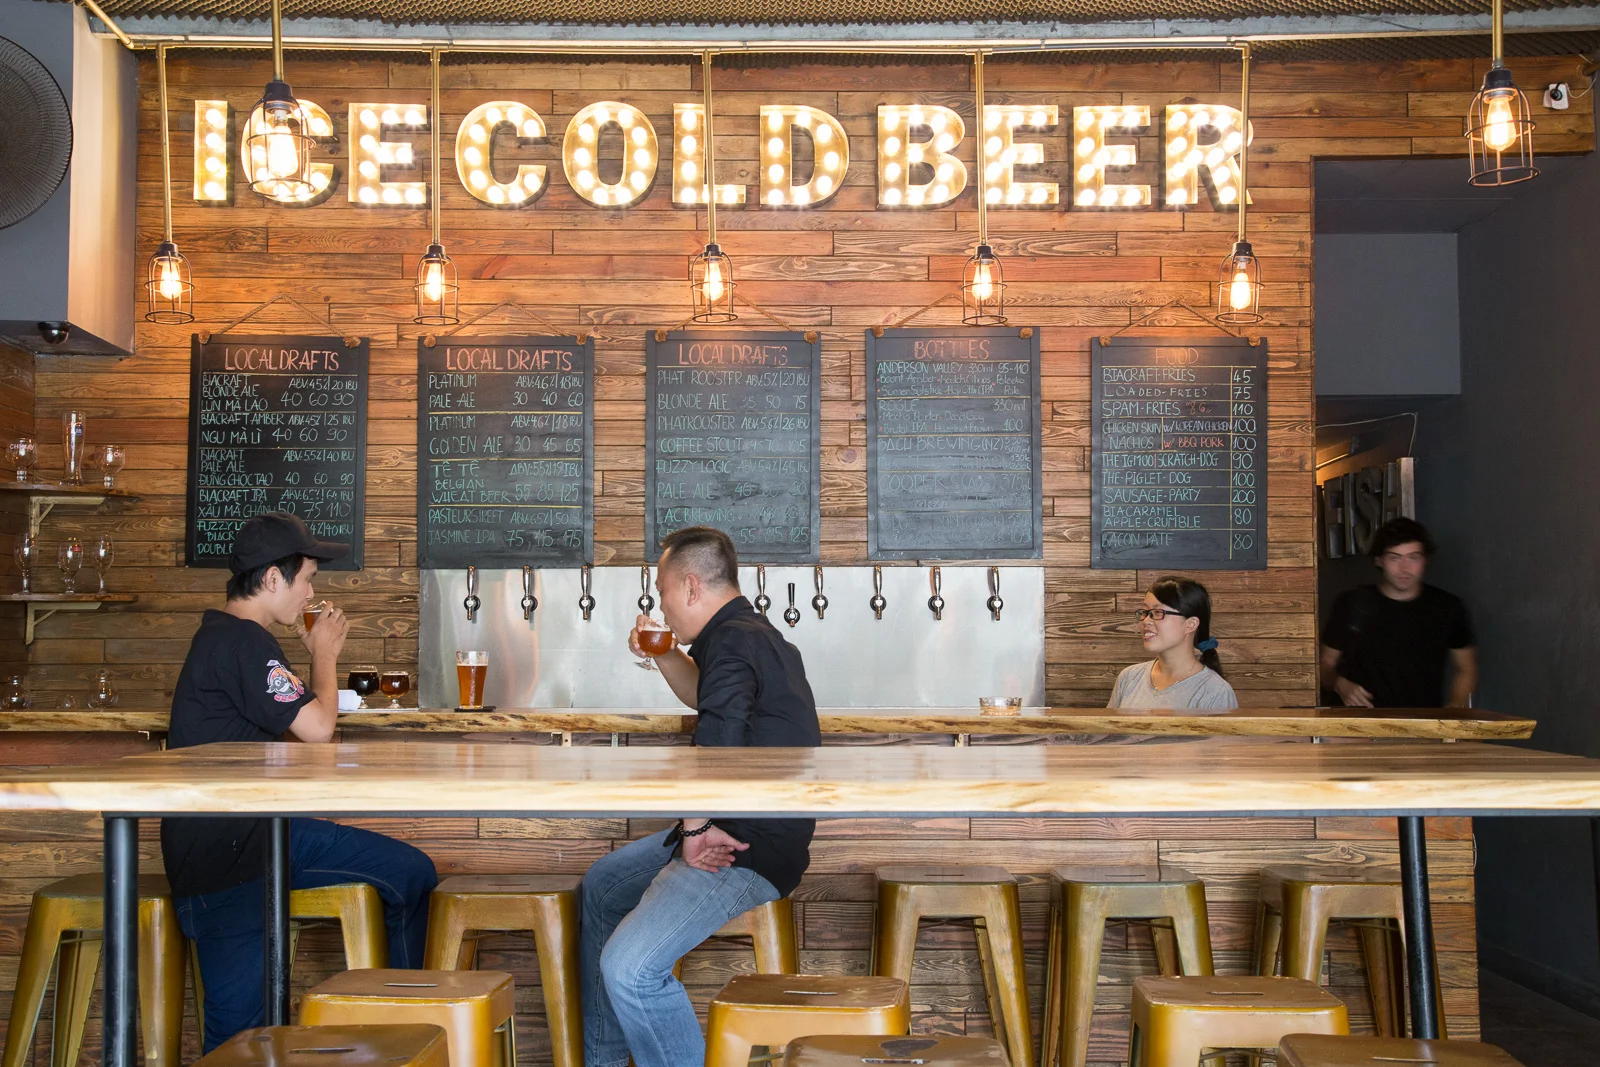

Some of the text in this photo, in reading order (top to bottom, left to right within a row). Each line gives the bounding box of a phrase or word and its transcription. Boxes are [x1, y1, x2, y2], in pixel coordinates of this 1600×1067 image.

[193, 98, 1254, 208] ICE COLD BEER
[679, 343, 788, 366] LOCAL DRAFTS
[914, 339, 991, 359] BOTTLES
[1155, 348, 1198, 365] FOOD
[225, 348, 339, 371] LOCAL DRAFTS
[446, 348, 572, 371] LOCAL DRAFTS
[877, 362, 929, 374] ANDERSON
[932, 363, 963, 374] VALLEY
[203, 374, 250, 387] BIACRAFT
[429, 374, 476, 389] PLATINUM
[657, 370, 685, 386] PHAT
[691, 370, 742, 386] ROOSTER
[1233, 370, 1251, 383] 45
[203, 384, 260, 397] BLONDE ALE
[1233, 387, 1251, 399] 75
[281, 391, 302, 407] 40
[309, 392, 328, 406] 60
[332, 393, 354, 406] 90
[429, 392, 584, 408] PALE ALE 30 40 60
[658, 394, 702, 410] BLONDE
[708, 394, 730, 410] ALE
[765, 395, 780, 409] 50
[793, 396, 807, 410] 75
[1233, 404, 1253, 415] 110
[201, 413, 249, 425] BIACRAFT
[251, 413, 284, 425] AMBER
[429, 415, 476, 431] PLATINUM
[1002, 419, 1023, 431] 100
[1102, 421, 1139, 434] CHICKEN
[1141, 422, 1161, 433] SKIN
[1233, 418, 1256, 432] 100
[202, 431, 225, 443] NGU
[230, 427, 247, 443] MÀ
[272, 429, 292, 442] 40
[300, 428, 318, 441] 60
[326, 429, 347, 441] 90
[1109, 436, 1154, 449] NACHOS
[1179, 436, 1197, 447] BBQ
[1200, 437, 1225, 447] PORK
[1233, 435, 1256, 450] 100
[483, 436, 503, 453] ALE
[514, 436, 530, 451] 30
[543, 438, 557, 451] 45
[566, 438, 582, 452] 65
[660, 438, 702, 453] COFFEE
[707, 437, 744, 452] STOUT
[917, 437, 981, 450] BREWING
[200, 450, 244, 461] BIACRAFT
[1233, 453, 1252, 469] 90
[201, 461, 245, 472] PALE ALE
[656, 460, 731, 474] FUZZY LOGIC
[285, 472, 300, 484] 40
[314, 473, 328, 484] 60
[341, 473, 354, 485] 90
[435, 479, 484, 490] BELGIAN
[1232, 472, 1255, 486] 100
[200, 489, 252, 502] BIACRAFT
[252, 489, 267, 501] IPA
[431, 484, 580, 504] WHEAT BEER 55 85 125
[657, 482, 686, 499] PALE
[693, 483, 715, 499] ALE
[1232, 490, 1255, 504] 200
[224, 501, 350, 518] MÀ 50 75 110
[1234, 508, 1251, 525] 80
[197, 521, 233, 531] FUZZY
[428, 529, 470, 545] JASMINE
[475, 529, 496, 544] IPA
[506, 530, 525, 546] 75
[740, 528, 756, 543] 55
[1102, 533, 1140, 547] BACON
[1234, 535, 1253, 549] 80
